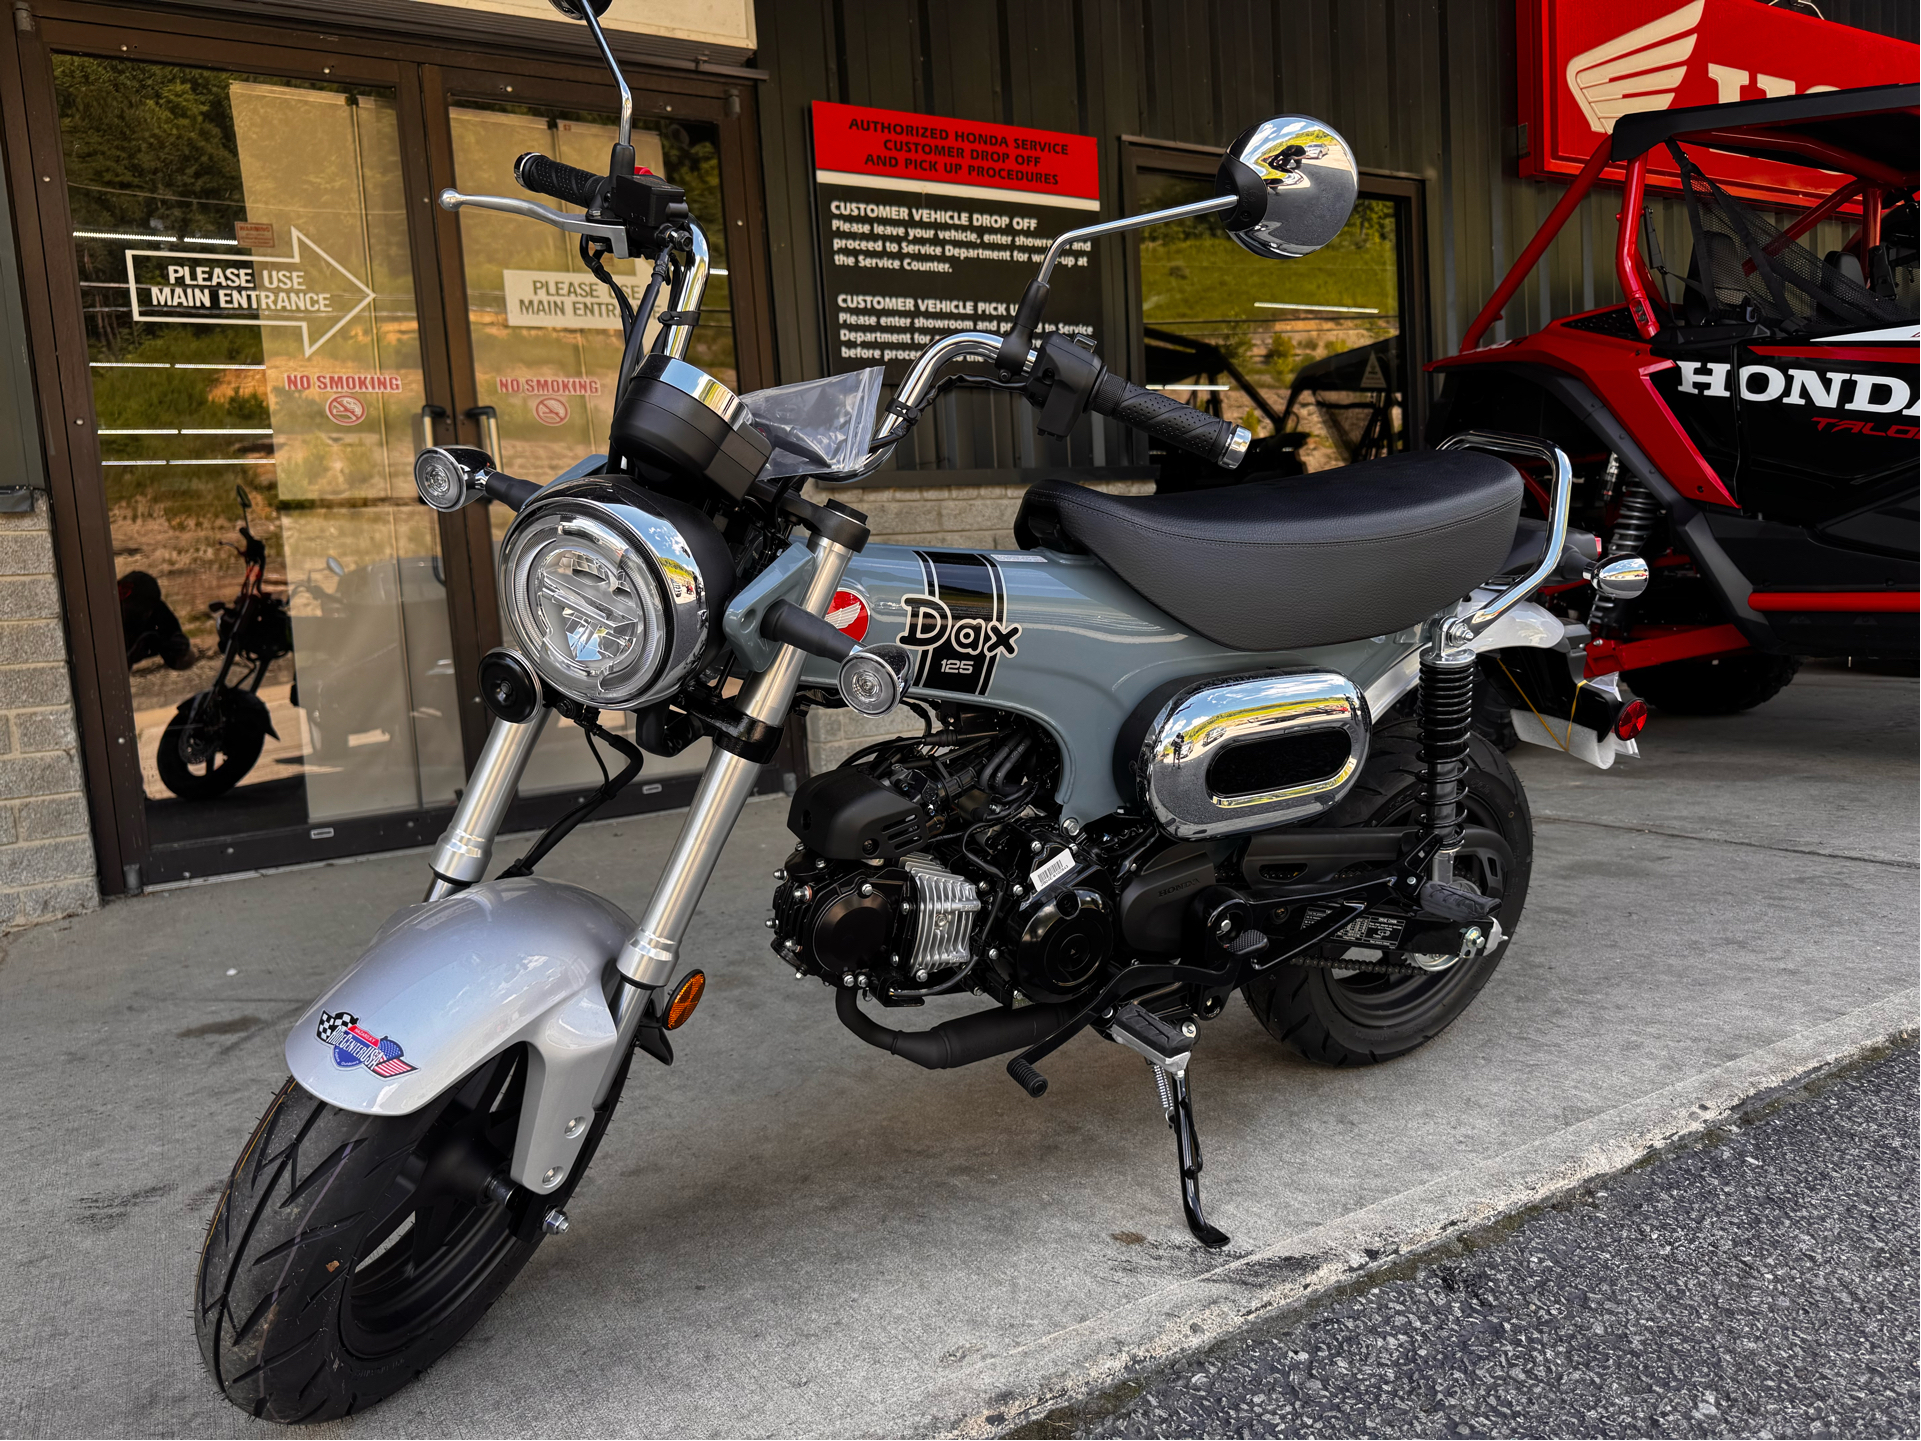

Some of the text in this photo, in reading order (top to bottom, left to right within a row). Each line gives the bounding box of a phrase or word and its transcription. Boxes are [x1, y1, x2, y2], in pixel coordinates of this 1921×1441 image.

[849, 118, 1069, 155] AUTHORIZED HONDA SERVICE
[883, 139, 1041, 167] CUSTOMER DROP OFF
[864, 154, 1059, 185] AND PICK UP PROCEDURES
[830, 201, 1038, 231] CUSTOMER VEHICLE DROP OFF
[832, 219, 1092, 251] Please leave your vehicle, enter showro and
[833, 238, 883, 252] proceed
[885, 241, 899, 253] to
[901, 241, 943, 256] Service
[944, 245, 1011, 260] Department
[1012, 249, 1030, 262] for
[1077, 256, 1088, 267] at
[834, 253, 953, 273] the Service Counter.
[168, 265, 307, 290] PLEASE USE
[151, 287, 333, 311] MAIN ENTRANCE
[532, 280, 601, 299] PLEASE
[519, 299, 662, 320] MAIN ENTRE
[837, 294, 915, 311] CUSTOMER
[917, 298, 975, 314] VEHICLE
[977, 302, 1008, 316] PICK
[839, 312, 877, 326] Please
[879, 315, 912, 328] enter
[914, 316, 974, 331] showroom
[976, 319, 998, 331] and
[1044, 322, 1057, 332] to
[1058, 323, 1094, 335] Service
[840, 329, 912, 344] Department
[913, 332, 930, 344] for
[841, 345, 882, 359] before
[286, 374, 401, 392] NO SMOKING
[499, 378, 599, 394] NO SMOKING
[1811, 417, 1920, 440] TALO
[896, 593, 1022, 658] Dax
[940, 659, 974, 674] 125
[1158, 878, 1201, 898] HONDA
